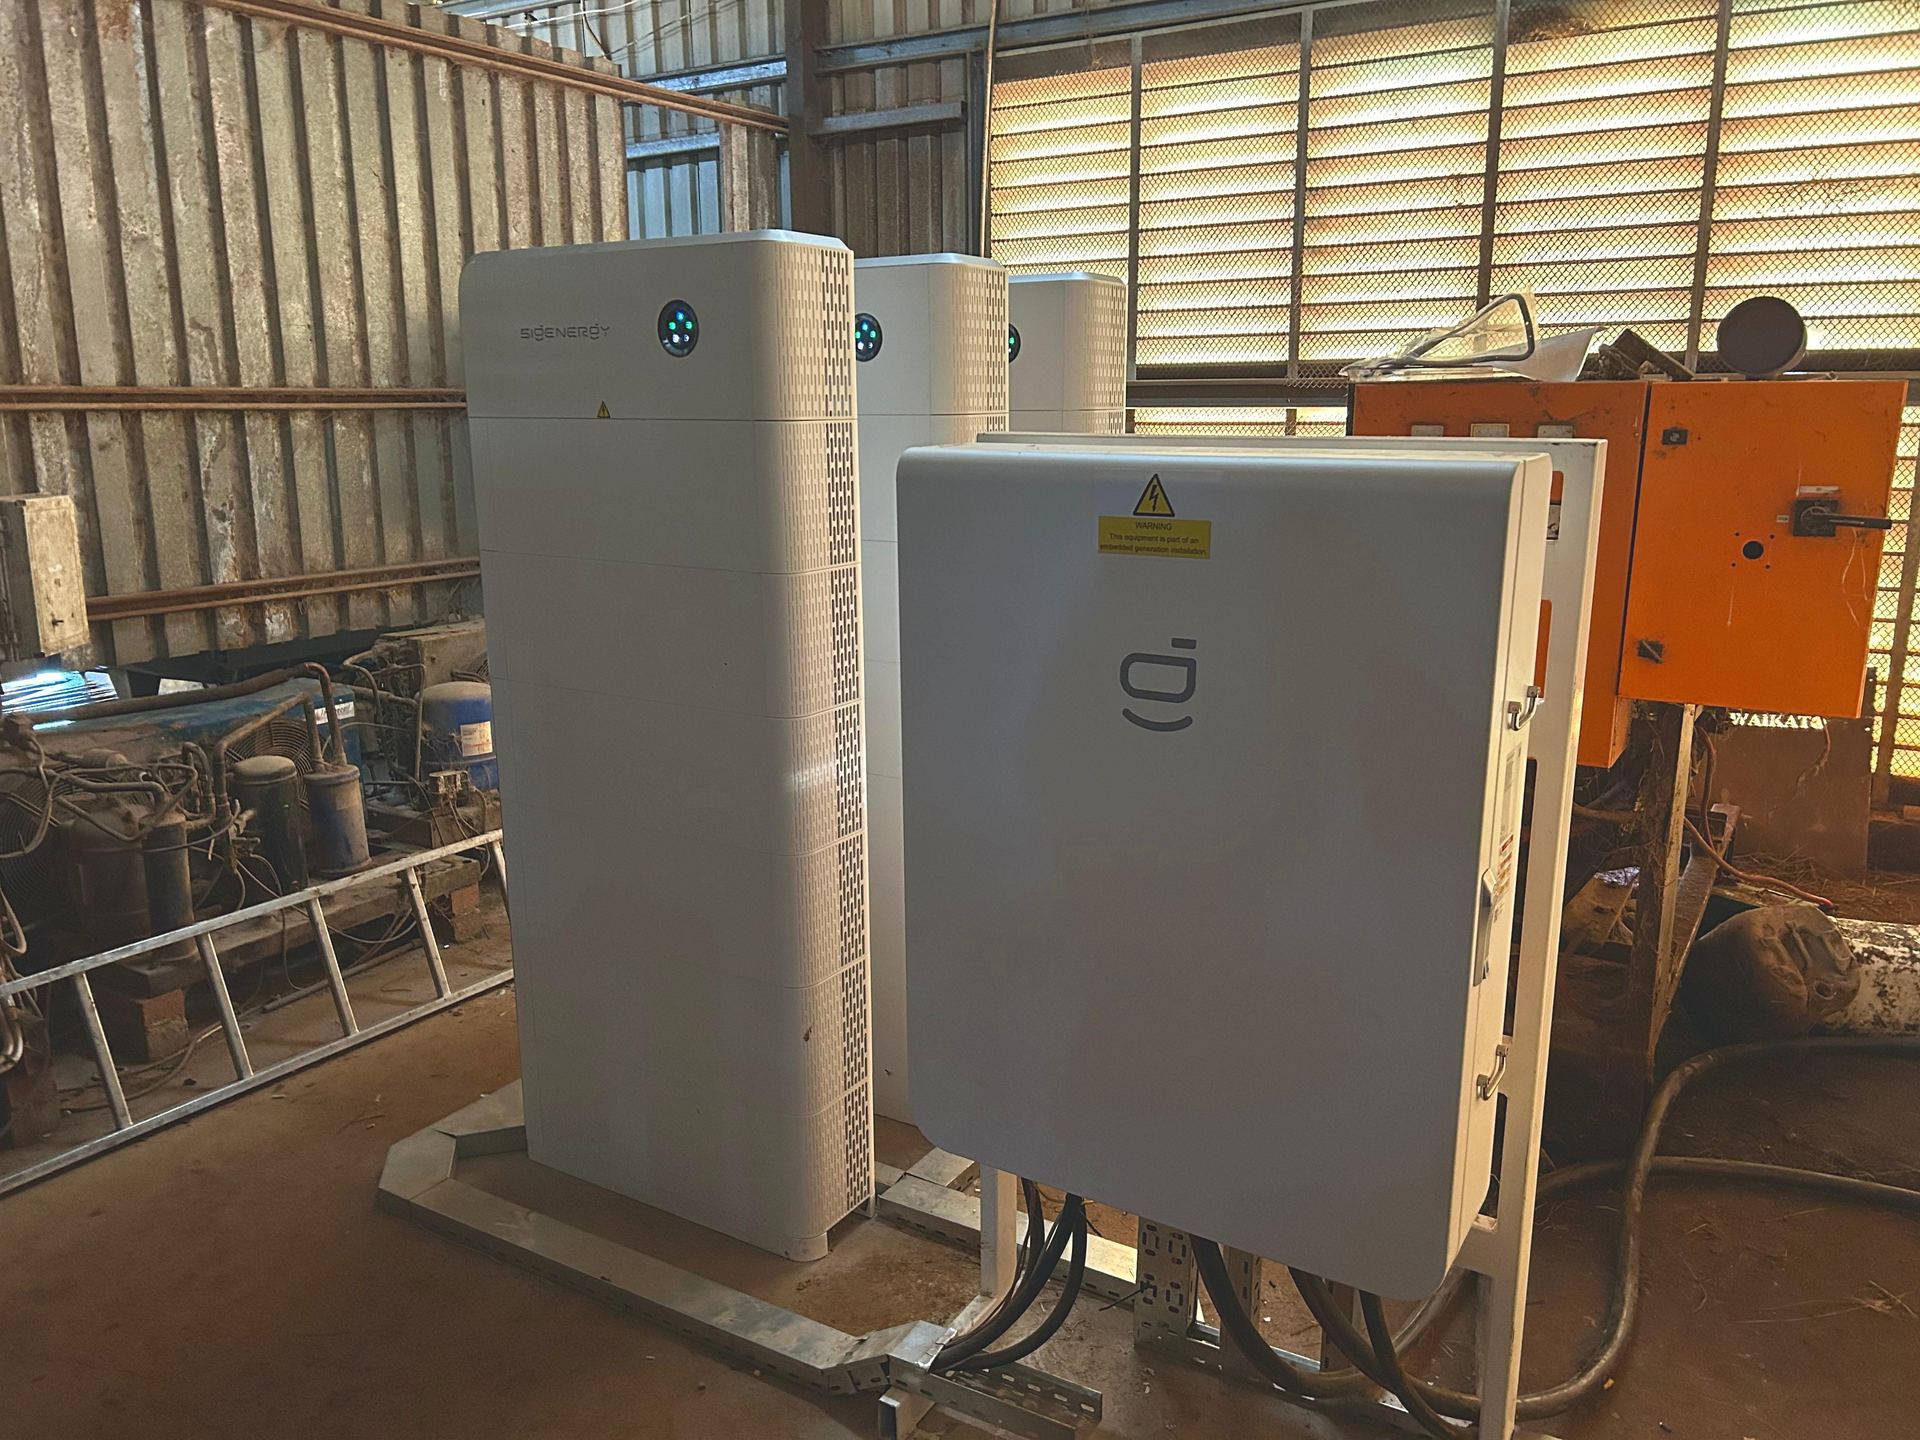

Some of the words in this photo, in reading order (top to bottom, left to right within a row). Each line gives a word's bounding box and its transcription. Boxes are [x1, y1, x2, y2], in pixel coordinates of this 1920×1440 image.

[520, 324, 610, 341] SIGENERGY
[1135, 521, 1173, 531] WARNING
[1124, 534, 1158, 542] equipment
[1167, 535, 1181, 544] part
[1134, 545, 1169, 553] generation
[1729, 712, 1827, 730] WAIKATO
